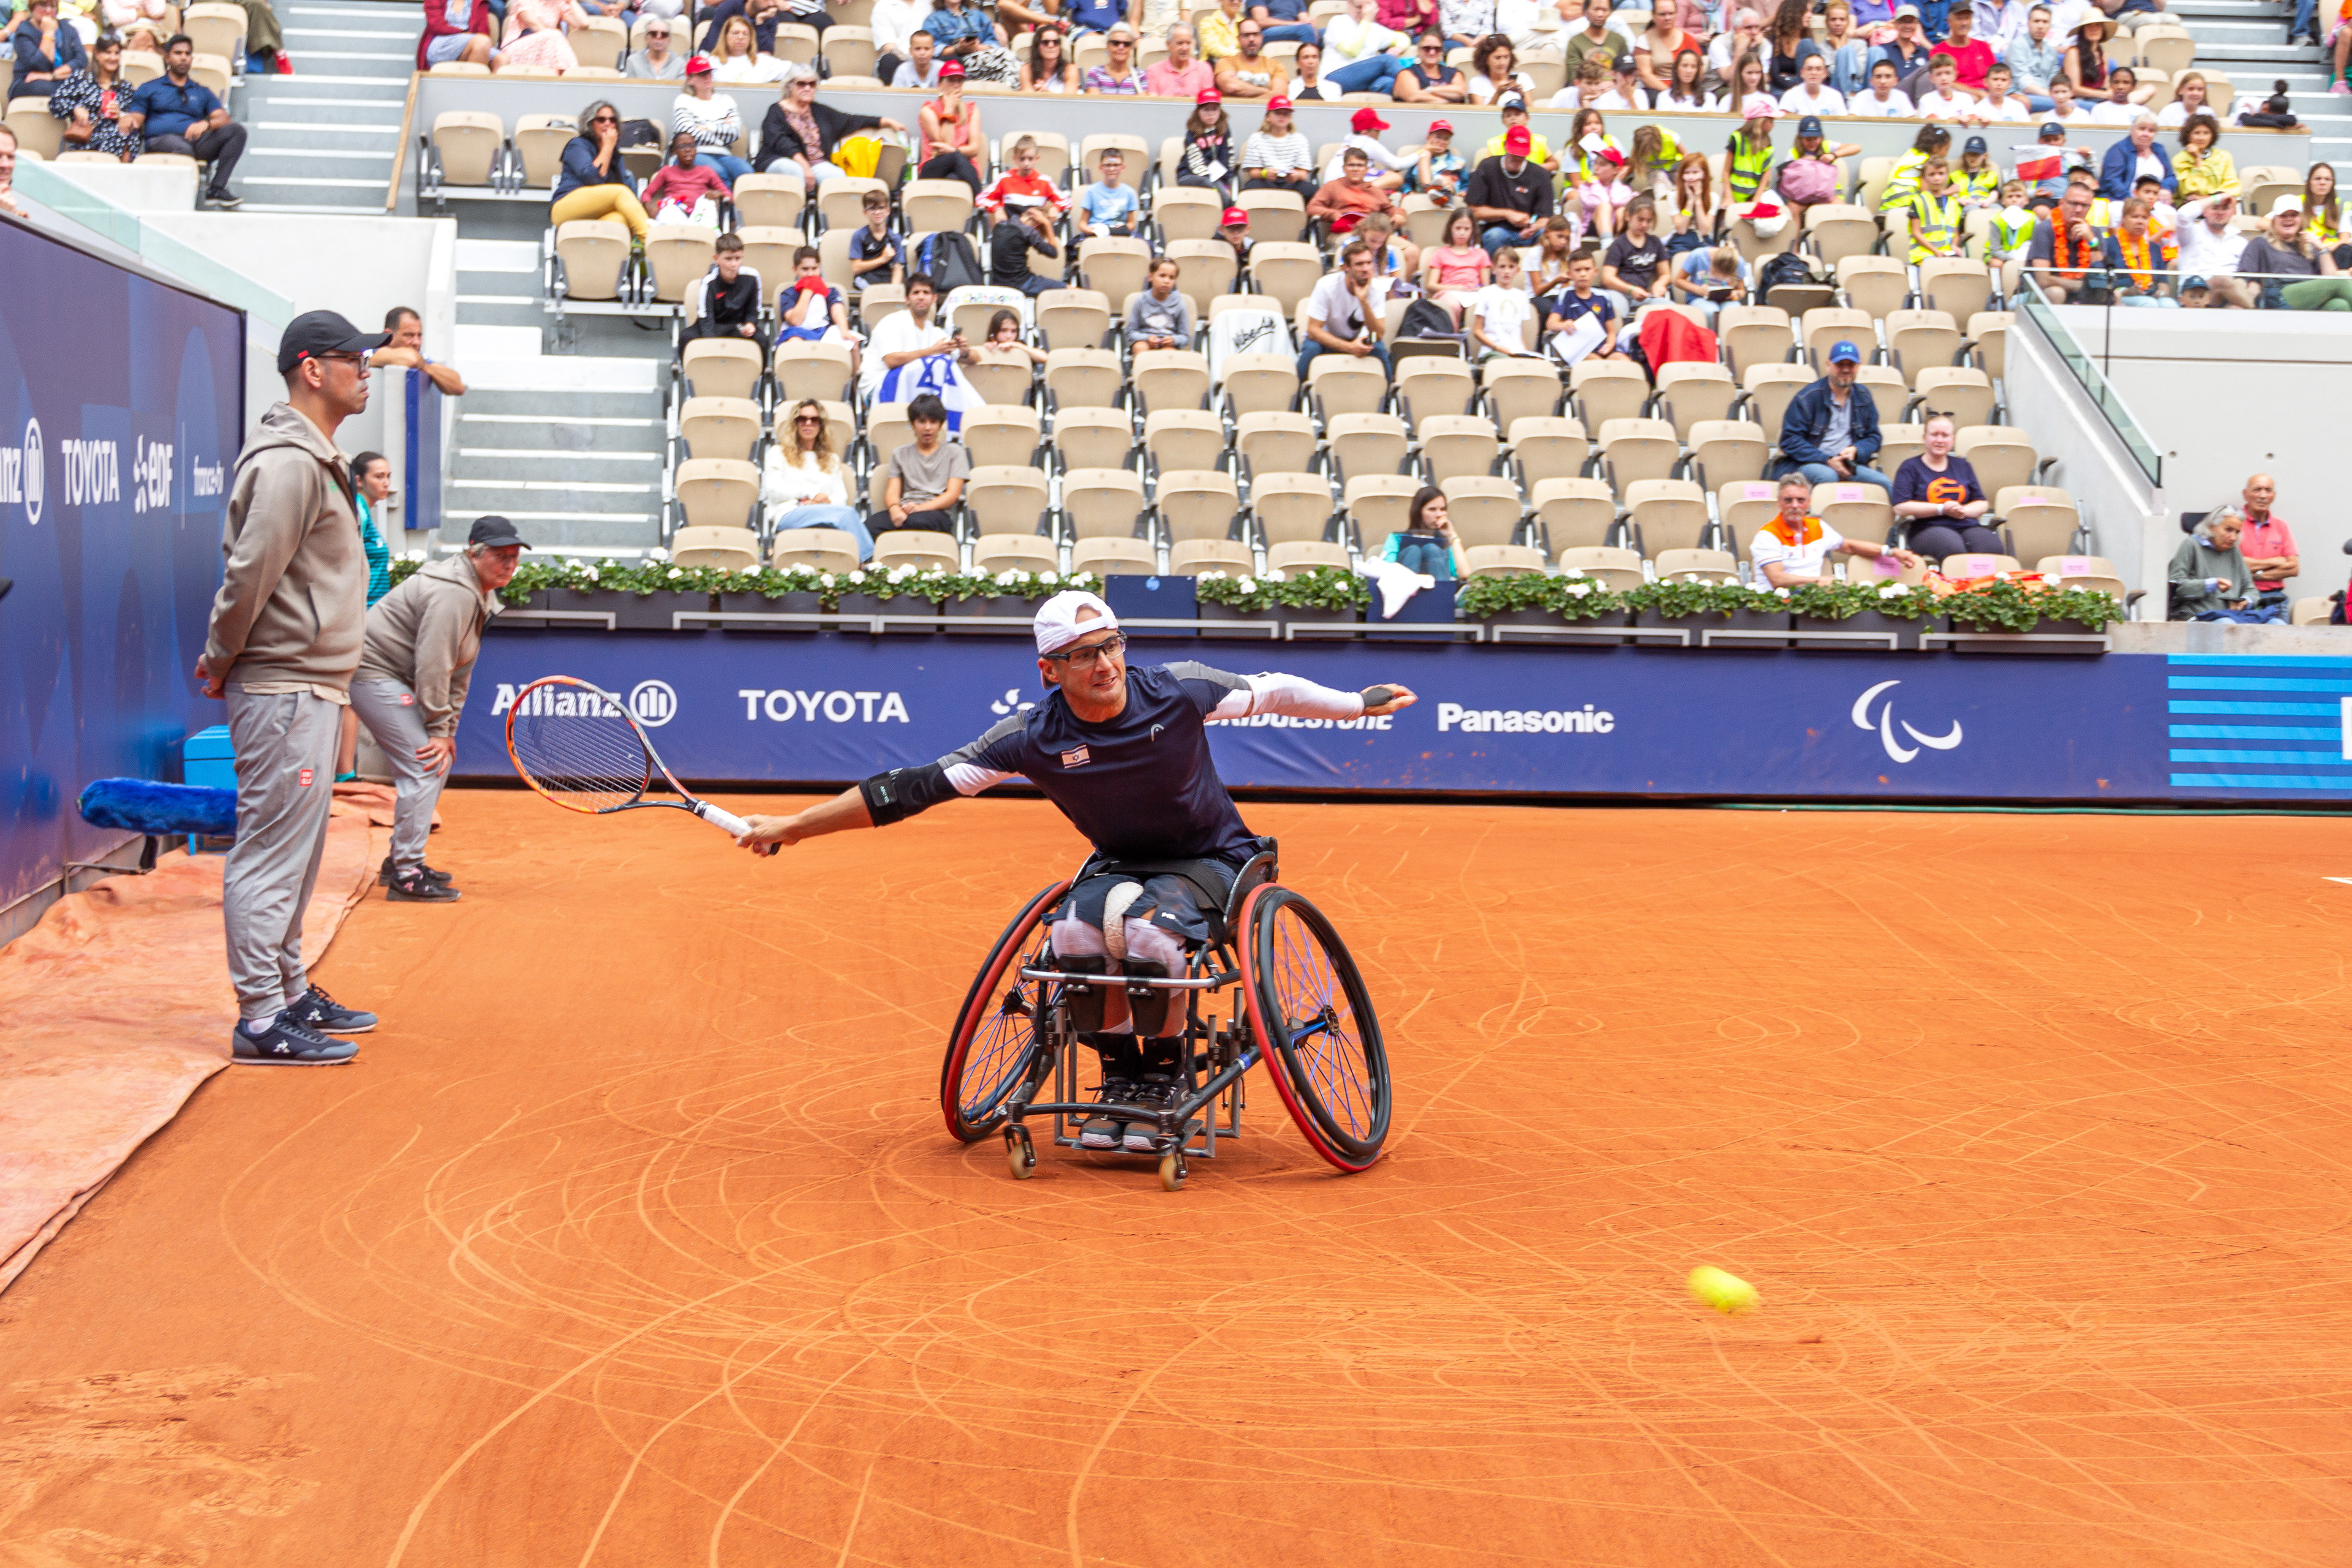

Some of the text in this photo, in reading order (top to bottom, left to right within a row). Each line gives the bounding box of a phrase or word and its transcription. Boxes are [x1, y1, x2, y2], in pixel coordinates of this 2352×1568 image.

[61, 439, 120, 506] TOYOTA
[738, 688, 910, 723] TOYOTA
[1437, 702, 1615, 733] Panasonic
